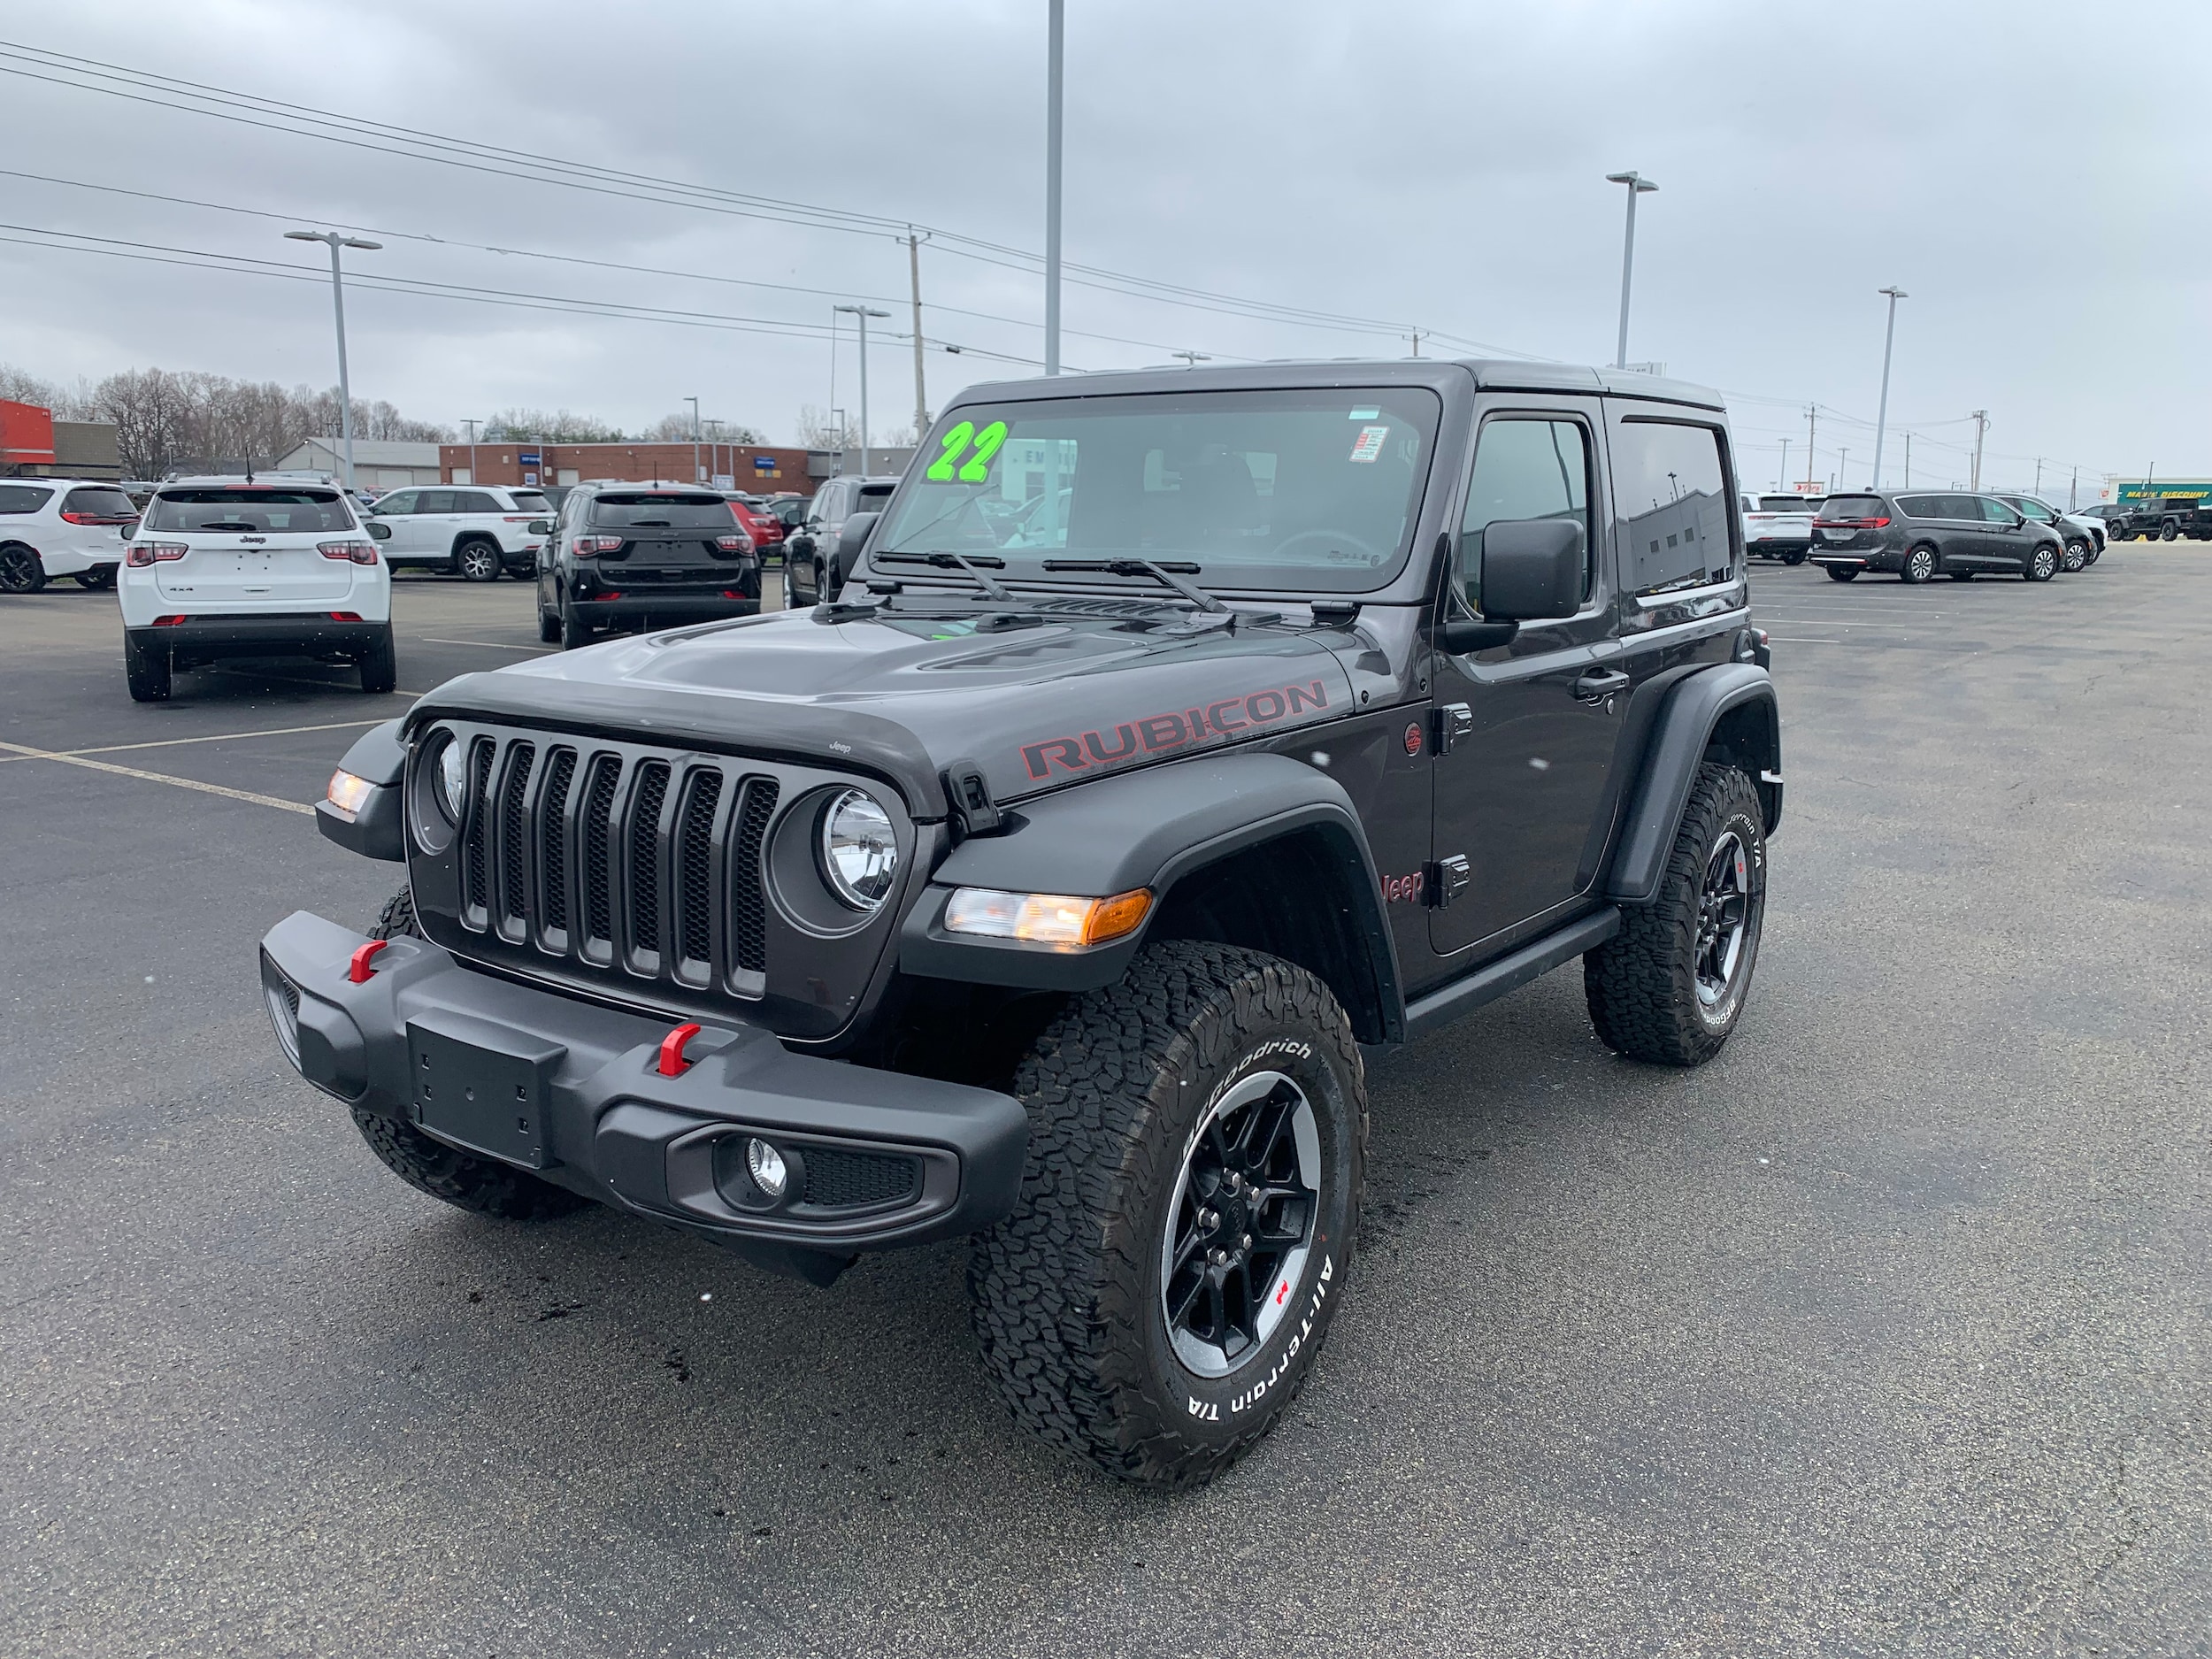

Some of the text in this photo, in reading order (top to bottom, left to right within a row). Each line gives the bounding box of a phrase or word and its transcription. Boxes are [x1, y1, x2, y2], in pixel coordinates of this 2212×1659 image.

[927, 420, 1008, 482] 22
[239, 535, 266, 544] Jeep
[1020, 680, 1328, 780] RUBICON
[829, 741, 851, 754] Jeep
[1753, 837, 1762, 868] T/A
[1381, 872, 1425, 902] Jeep
[1187, 1254, 1333, 1421] All-Terrain T/A
